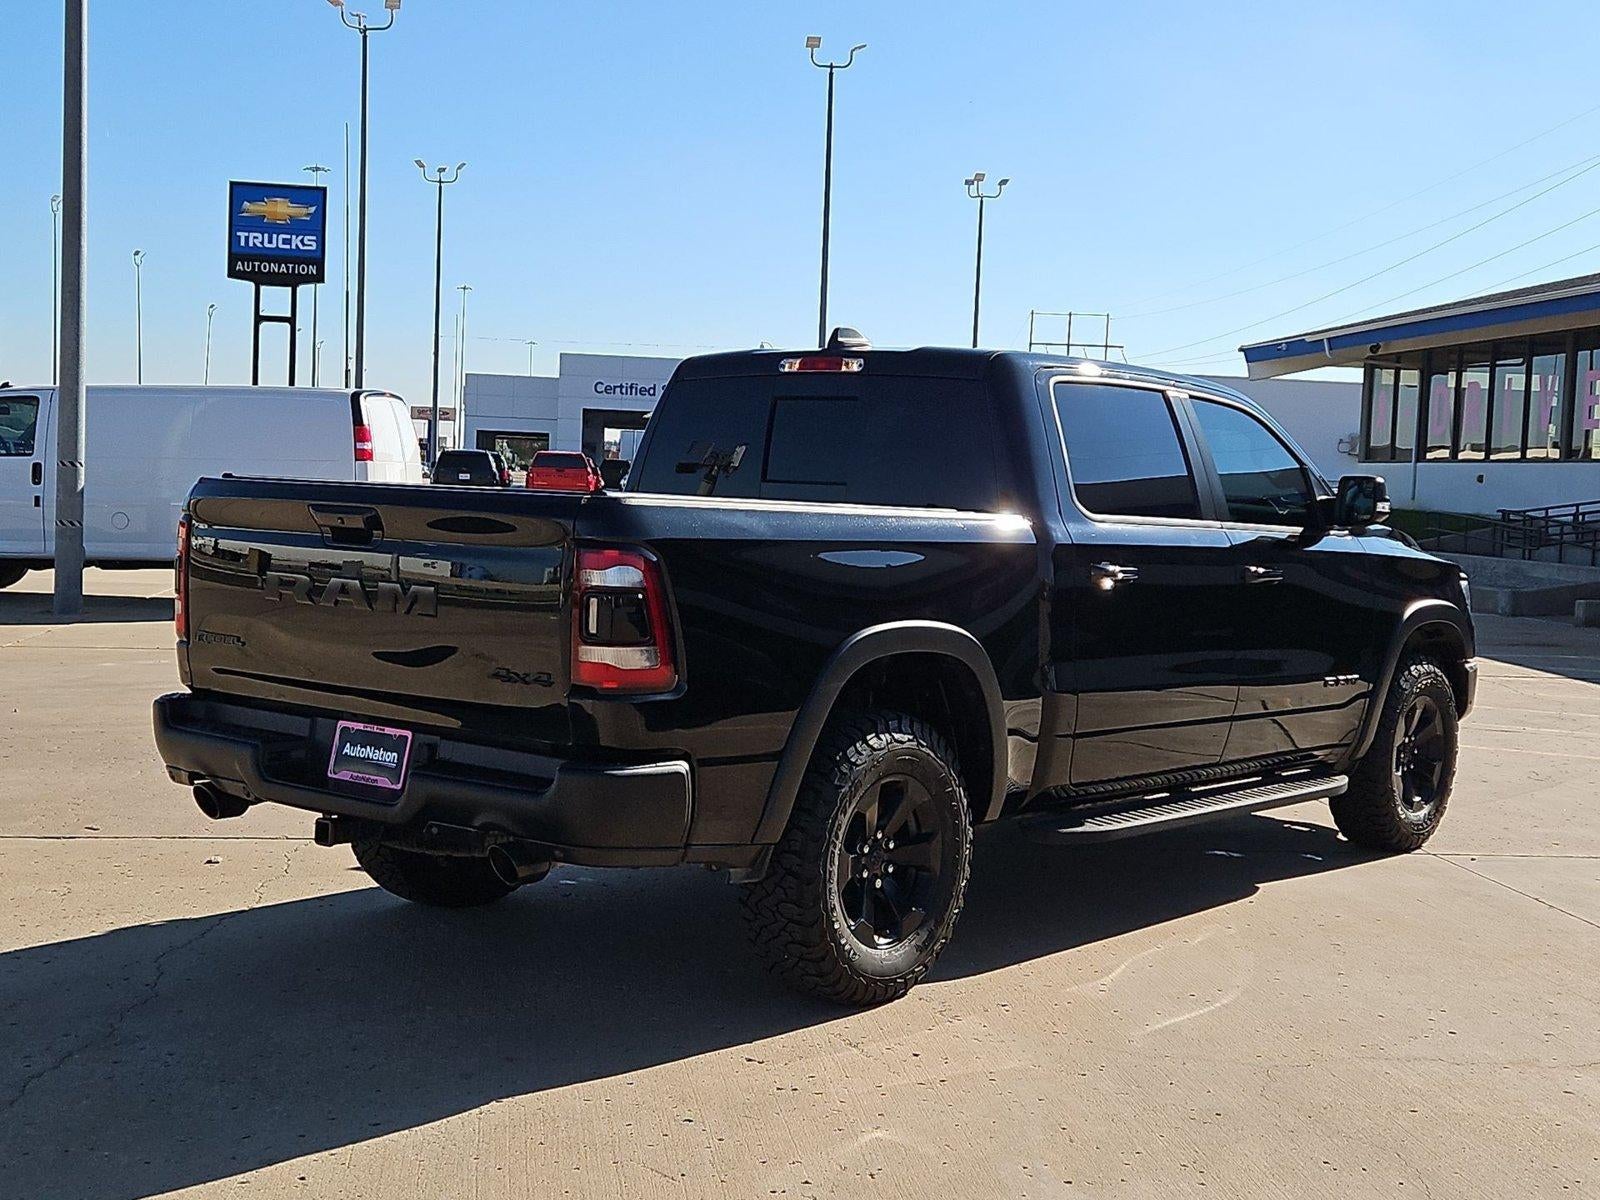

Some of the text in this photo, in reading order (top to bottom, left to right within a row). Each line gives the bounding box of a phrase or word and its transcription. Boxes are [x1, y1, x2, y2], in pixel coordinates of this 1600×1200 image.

[236, 231, 317, 250] TRUCKS
[235, 261, 317, 275] AUTONATION
[593, 381, 657, 397] Certified
[264, 571, 438, 618] RAM
[342, 742, 398, 762] AutoNation
